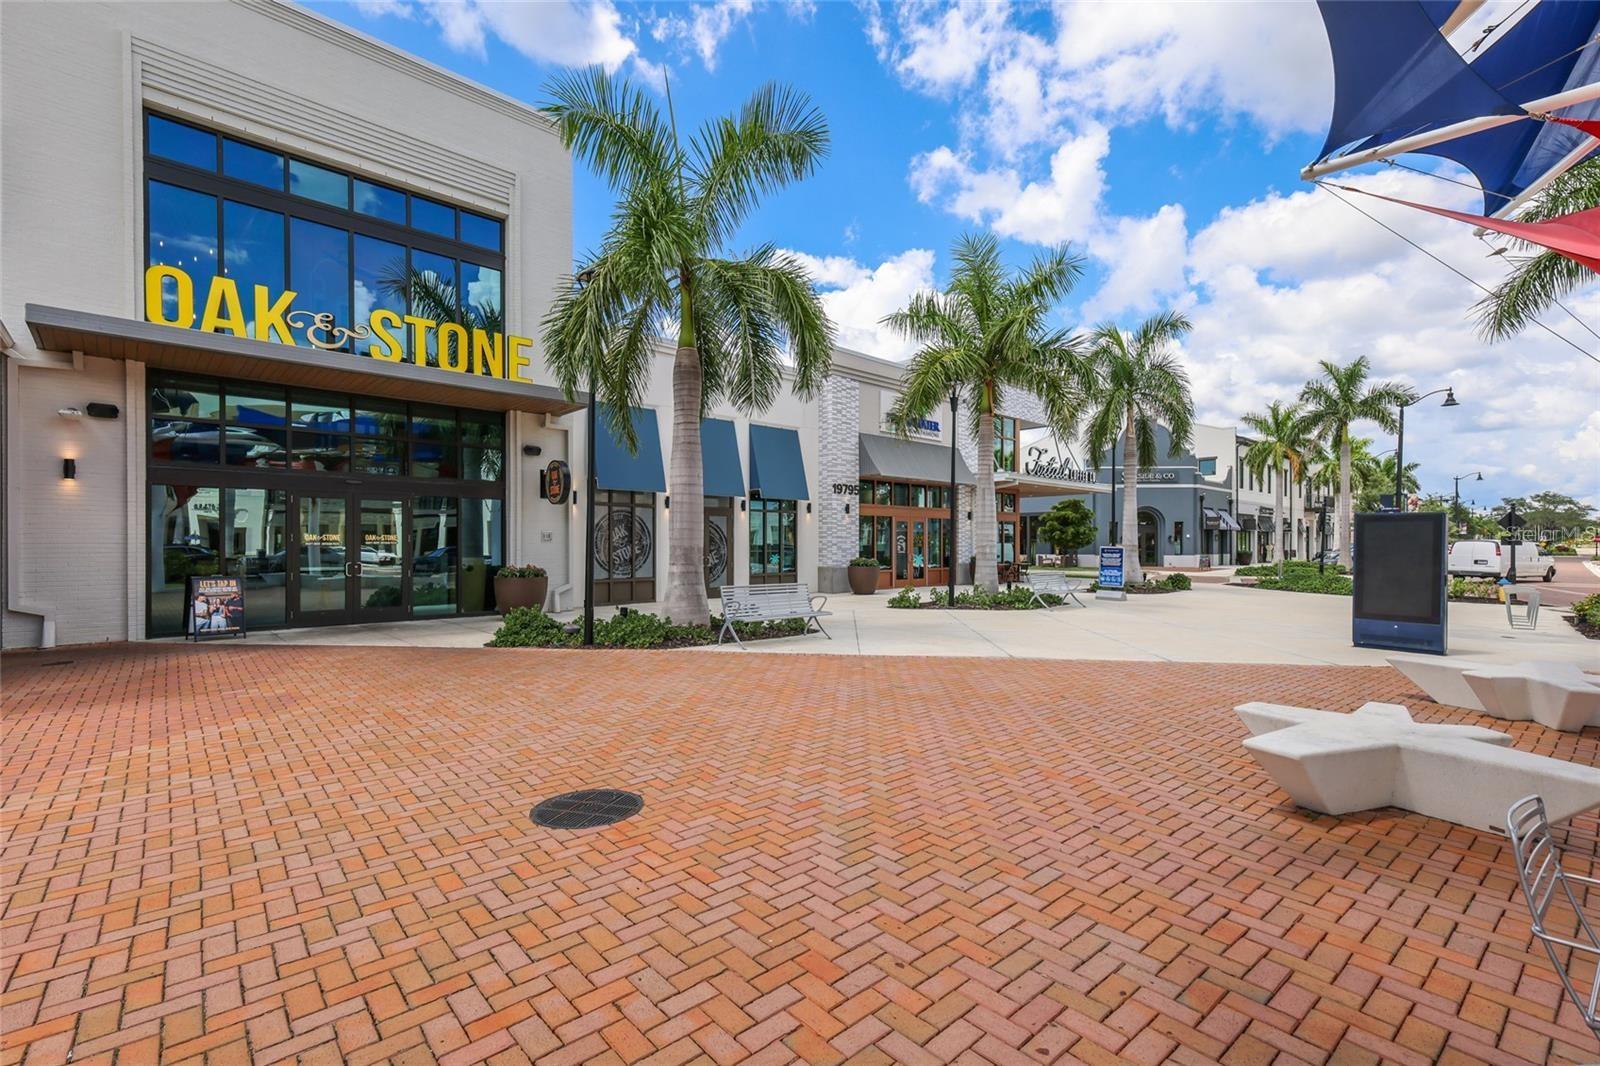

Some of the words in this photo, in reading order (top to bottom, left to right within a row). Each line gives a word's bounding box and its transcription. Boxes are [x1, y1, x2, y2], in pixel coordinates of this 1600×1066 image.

[145, 265, 298, 346] OAK
[286, 311, 371, 349] &
[369, 309, 533, 385] STONE
[1163, 472, 1175, 480] CO
[832, 483, 859, 496] 19795
[381, 534, 398, 542] STONE
